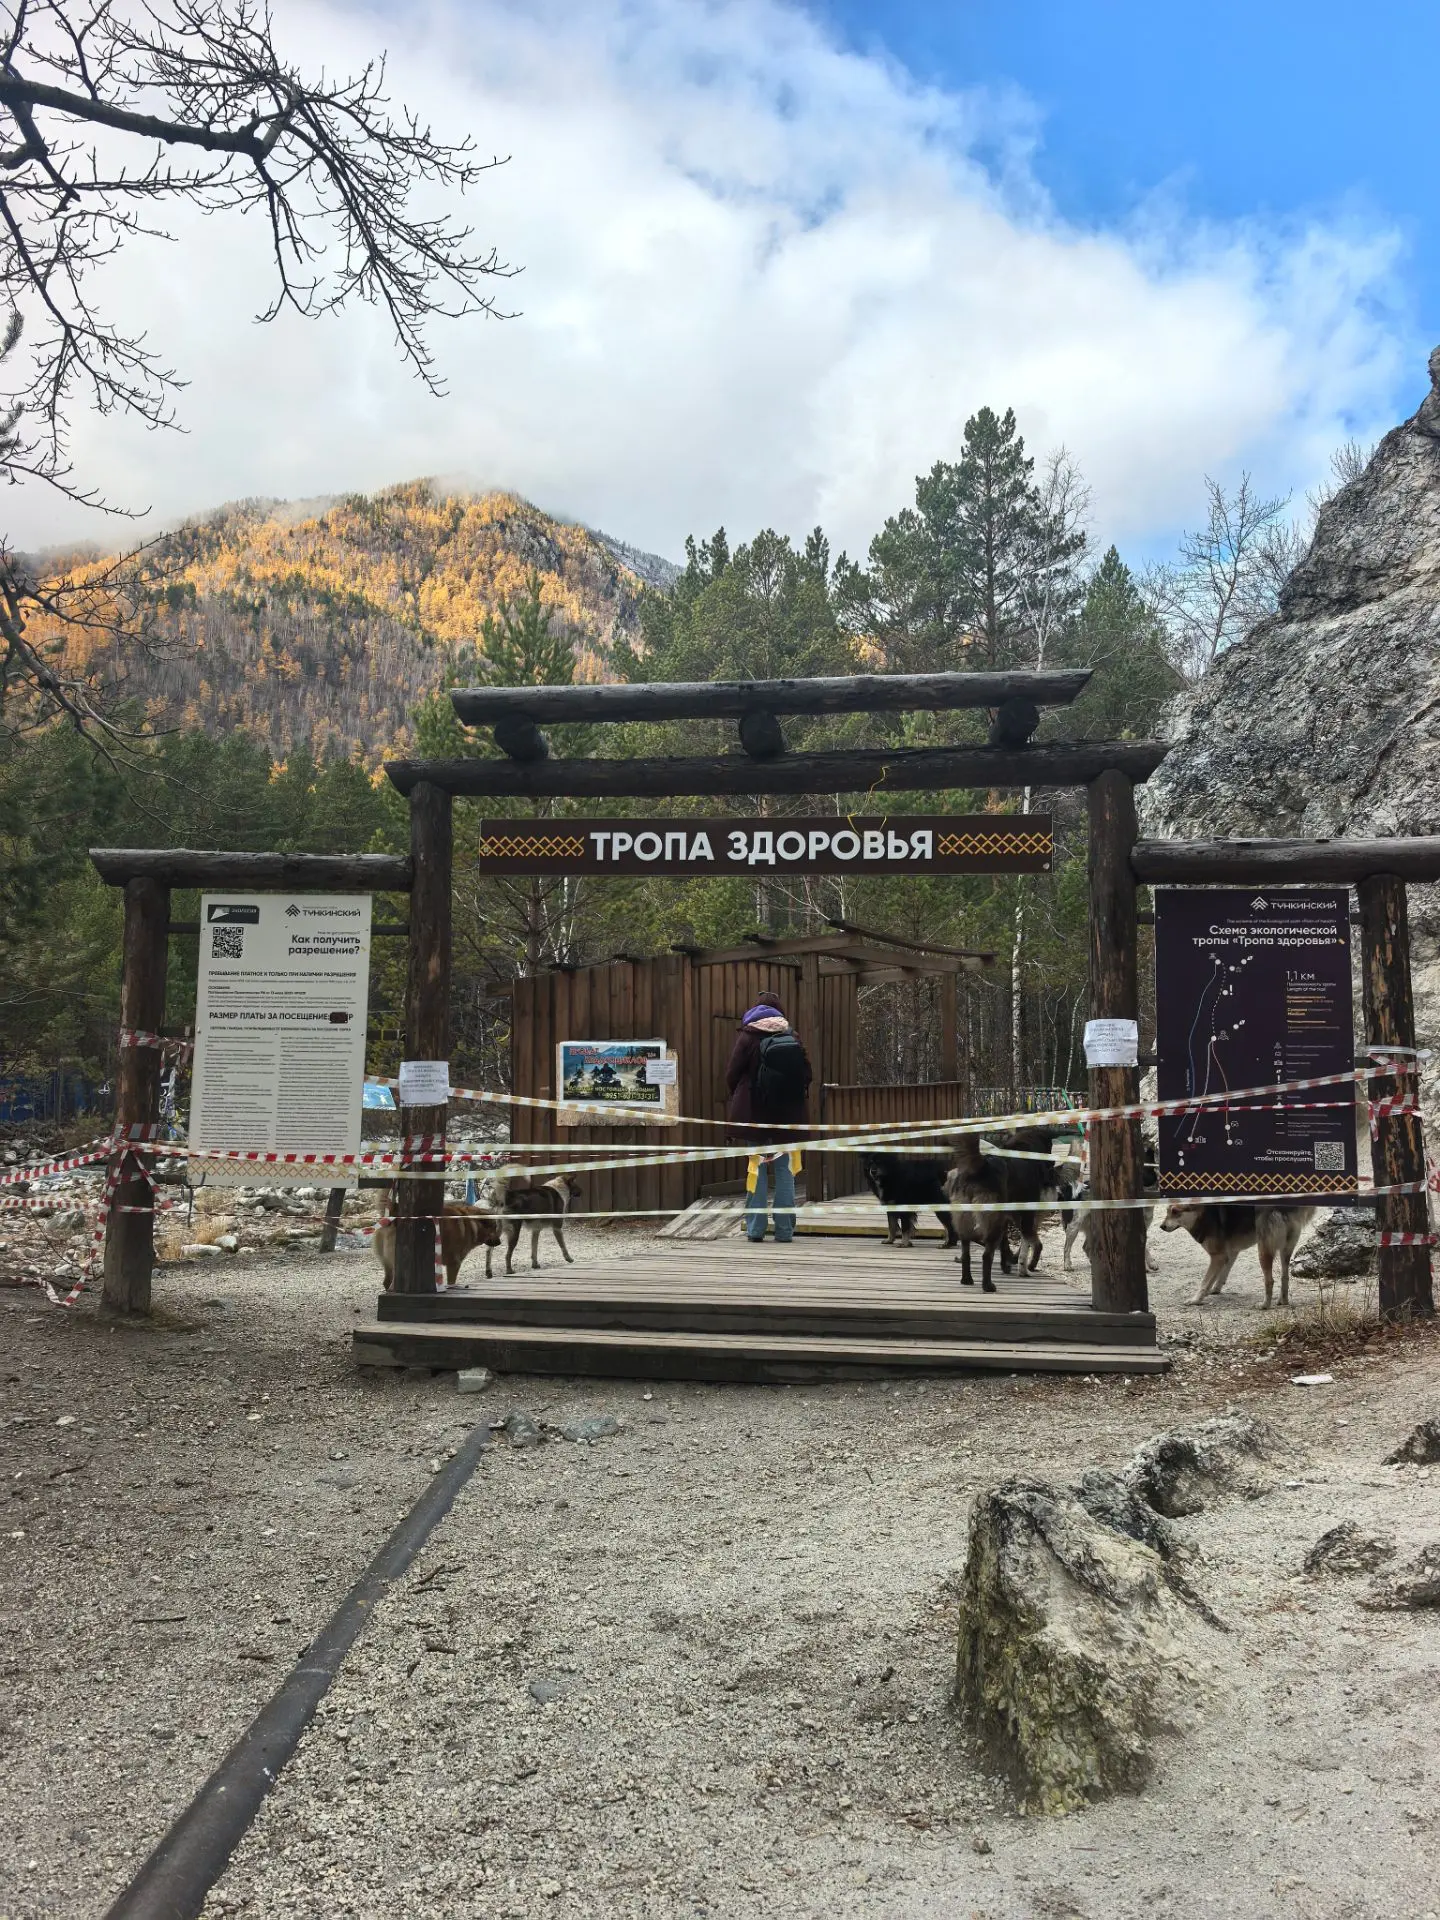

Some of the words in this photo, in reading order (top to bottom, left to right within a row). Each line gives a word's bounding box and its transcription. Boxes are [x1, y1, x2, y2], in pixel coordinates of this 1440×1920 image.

[589, 831, 715, 861] ТРОПА
[726, 830, 933, 865] ЗДОРОВЬЯ
[1209, 925, 1247, 935] Схема
[1250, 925, 1337, 935] экологической
[291, 934, 311, 944] Как
[312, 936, 361, 946] получить
[1192, 937, 1229, 948] тропы
[1232, 936, 1274, 948] «Тропа
[1277, 937, 1337, 948] здоровья»
[288, 946, 360, 956] разрешение?
[1300, 973, 1315, 981] км
[267, 1012, 278, 1020] ЗА
